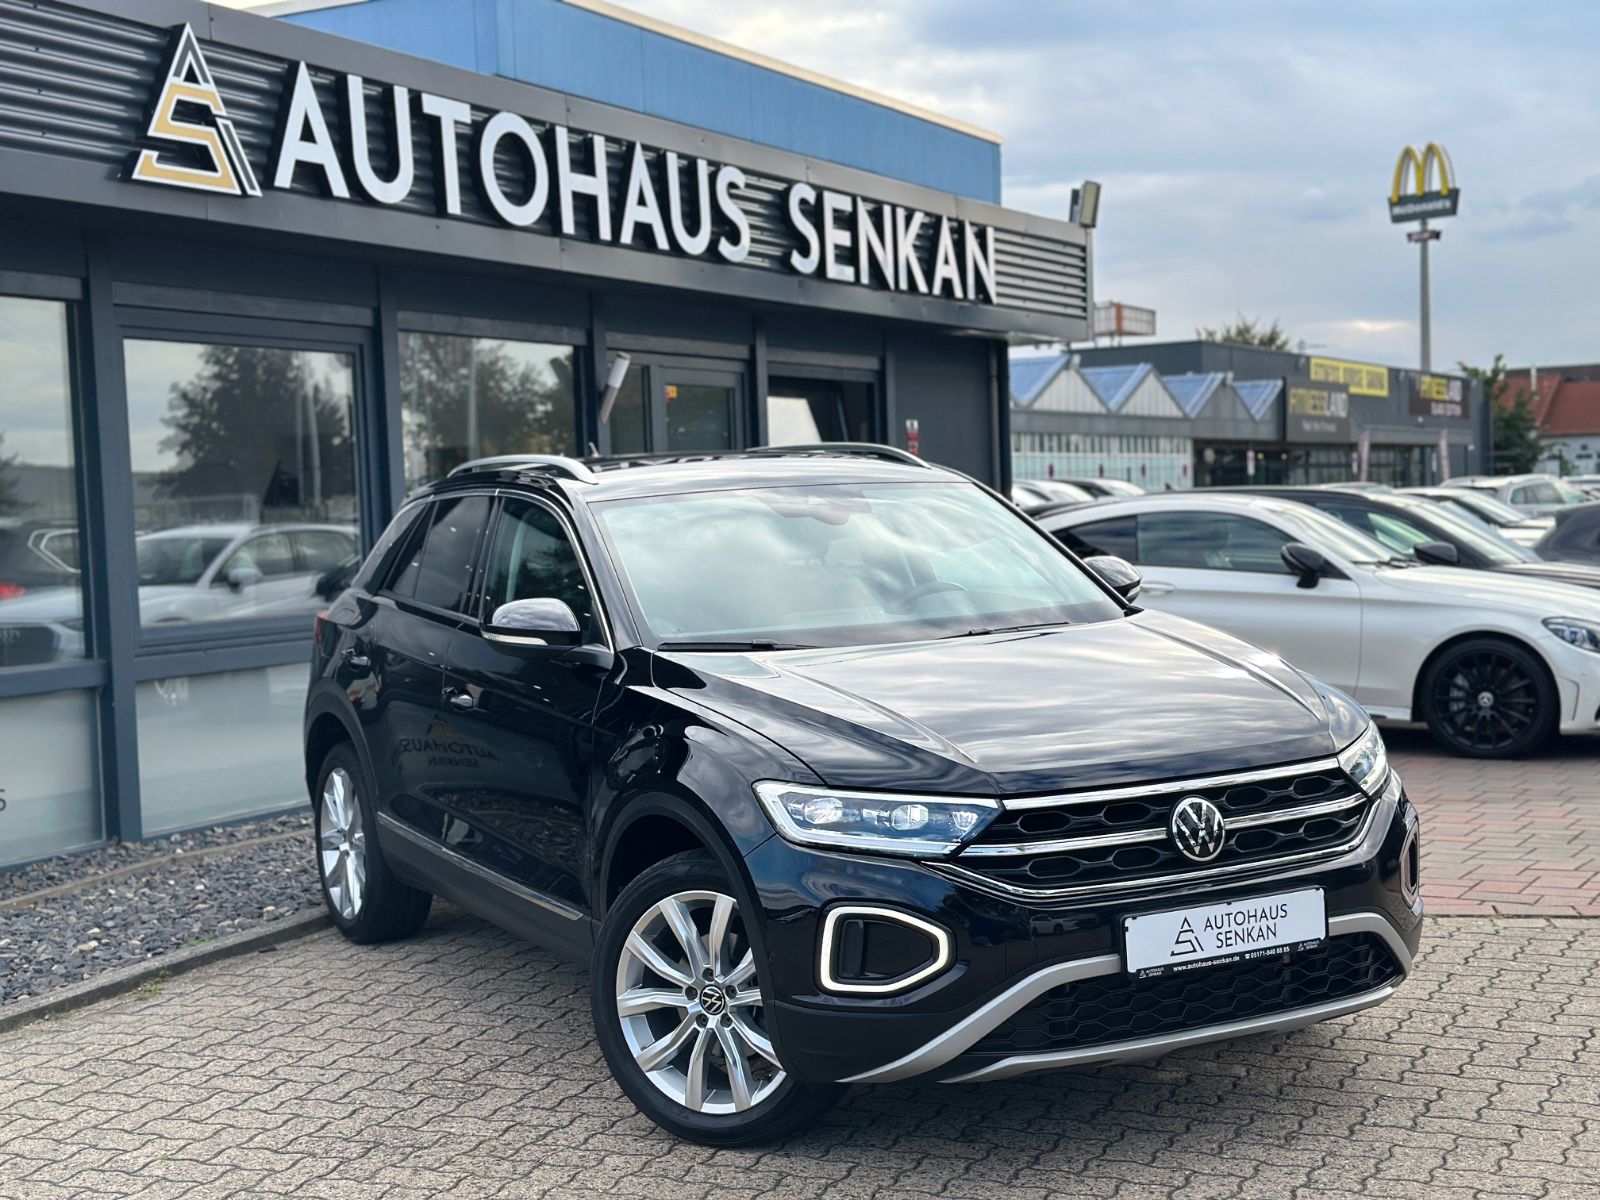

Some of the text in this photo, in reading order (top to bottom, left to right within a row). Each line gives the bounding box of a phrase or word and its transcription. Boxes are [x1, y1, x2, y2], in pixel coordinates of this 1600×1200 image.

[273, 60, 997, 304] AUTOHAUS SENKAN
[1203, 903, 1288, 932] AUTOHAUS
[1216, 922, 1277, 949] SENKAN
[1173, 955, 1240, 972] www.autohaus-senkan.de
